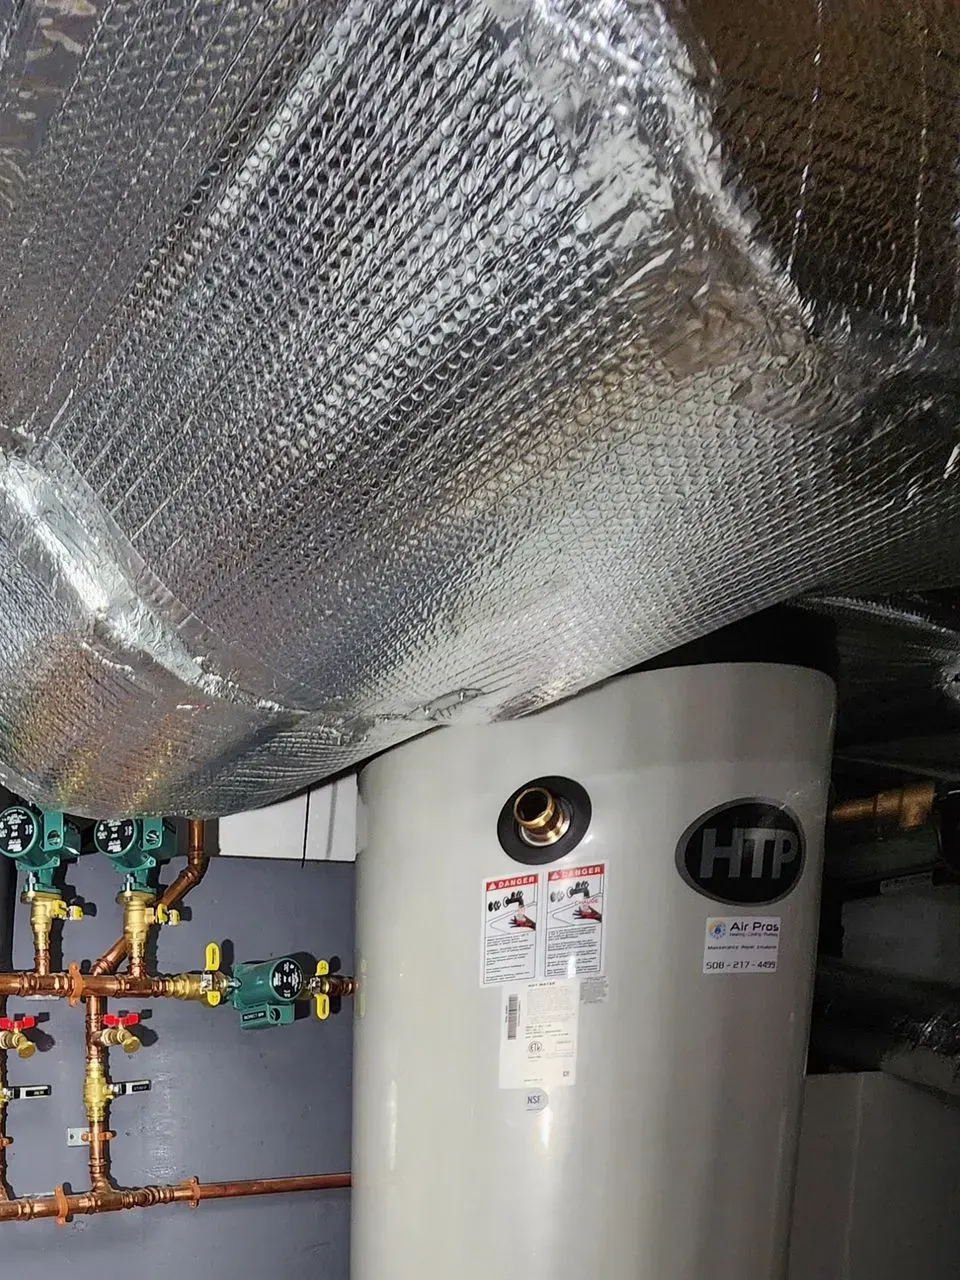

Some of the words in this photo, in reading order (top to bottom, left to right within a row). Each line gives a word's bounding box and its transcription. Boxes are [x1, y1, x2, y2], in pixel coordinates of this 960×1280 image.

[699, 827, 799, 879] HTP
[562, 868, 601, 878] DANGER
[498, 876, 535, 888] DANGER
[730, 921, 749, 931] Air
[753, 921, 779, 931] Pros
[706, 961, 724, 969] 508
[733, 961, 750, 969] 217
[527, 1096, 541, 1104] NSF
